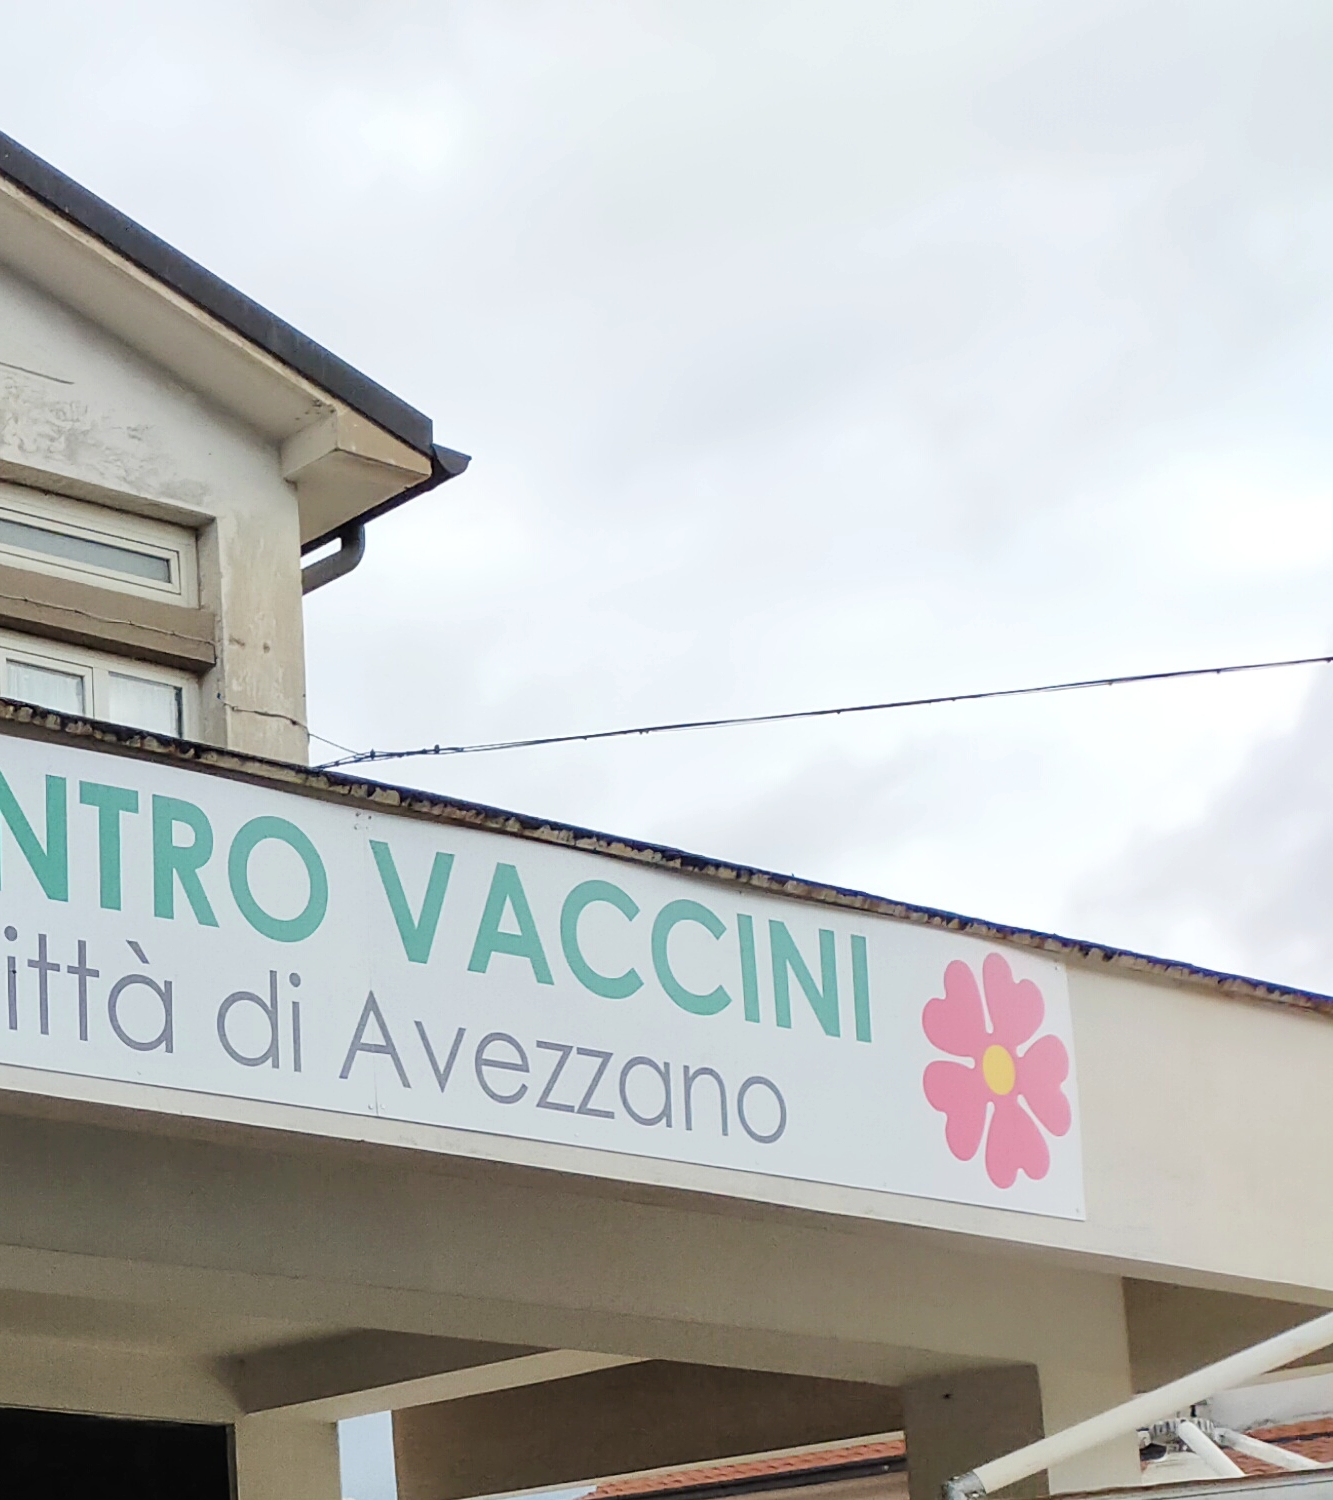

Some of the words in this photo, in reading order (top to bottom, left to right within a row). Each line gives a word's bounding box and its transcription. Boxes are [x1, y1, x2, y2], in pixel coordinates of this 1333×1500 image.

[369, 839, 872, 1043] VACCINI
[216, 969, 303, 1073] di
[338, 990, 788, 1145] Avezzano
